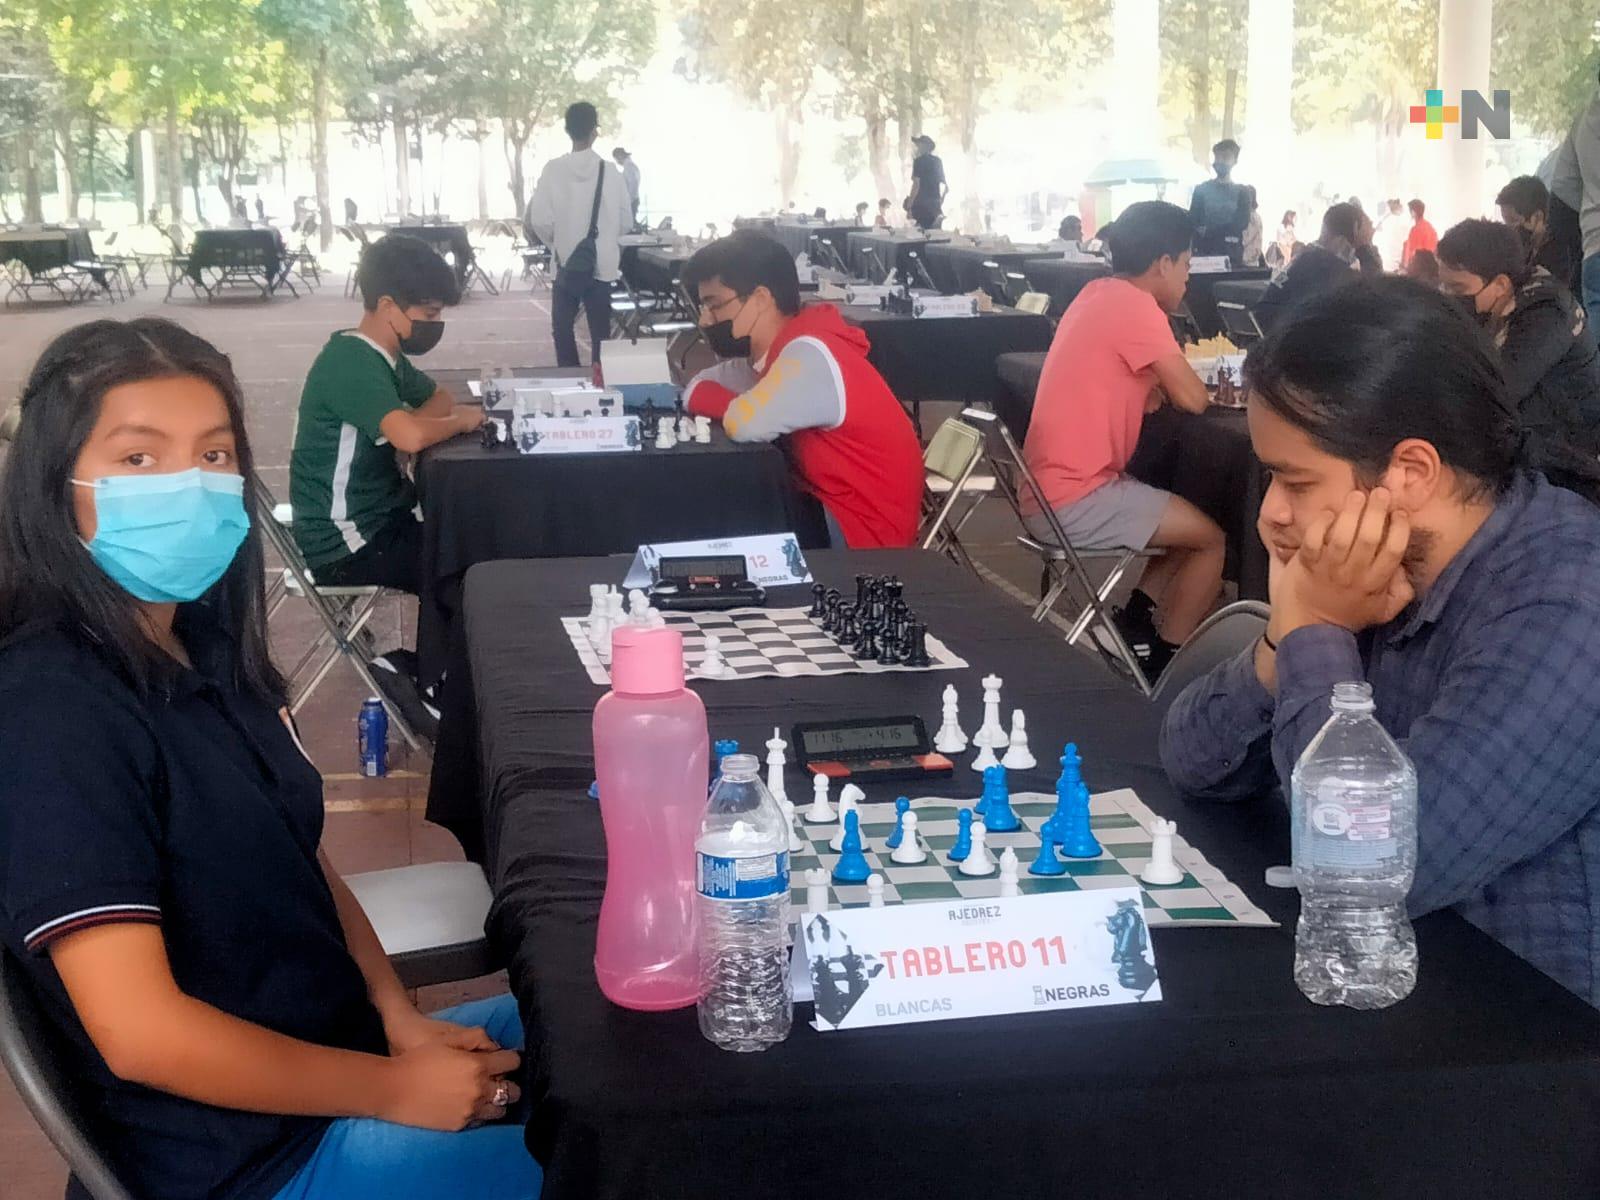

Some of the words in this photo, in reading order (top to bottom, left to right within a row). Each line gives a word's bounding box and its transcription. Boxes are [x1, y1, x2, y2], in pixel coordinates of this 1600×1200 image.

[545, 429, 596, 440] TABLERO
[598, 428, 613, 439] 27
[749, 554, 769, 568] 12
[948, 905, 1002, 921] AJEDREZ
[880, 939, 1027, 979] TABLERO
[1031, 935, 1067, 967] 11
[1044, 983, 1110, 1002] NEGRAS
[875, 997, 953, 1017] BLANCAS
